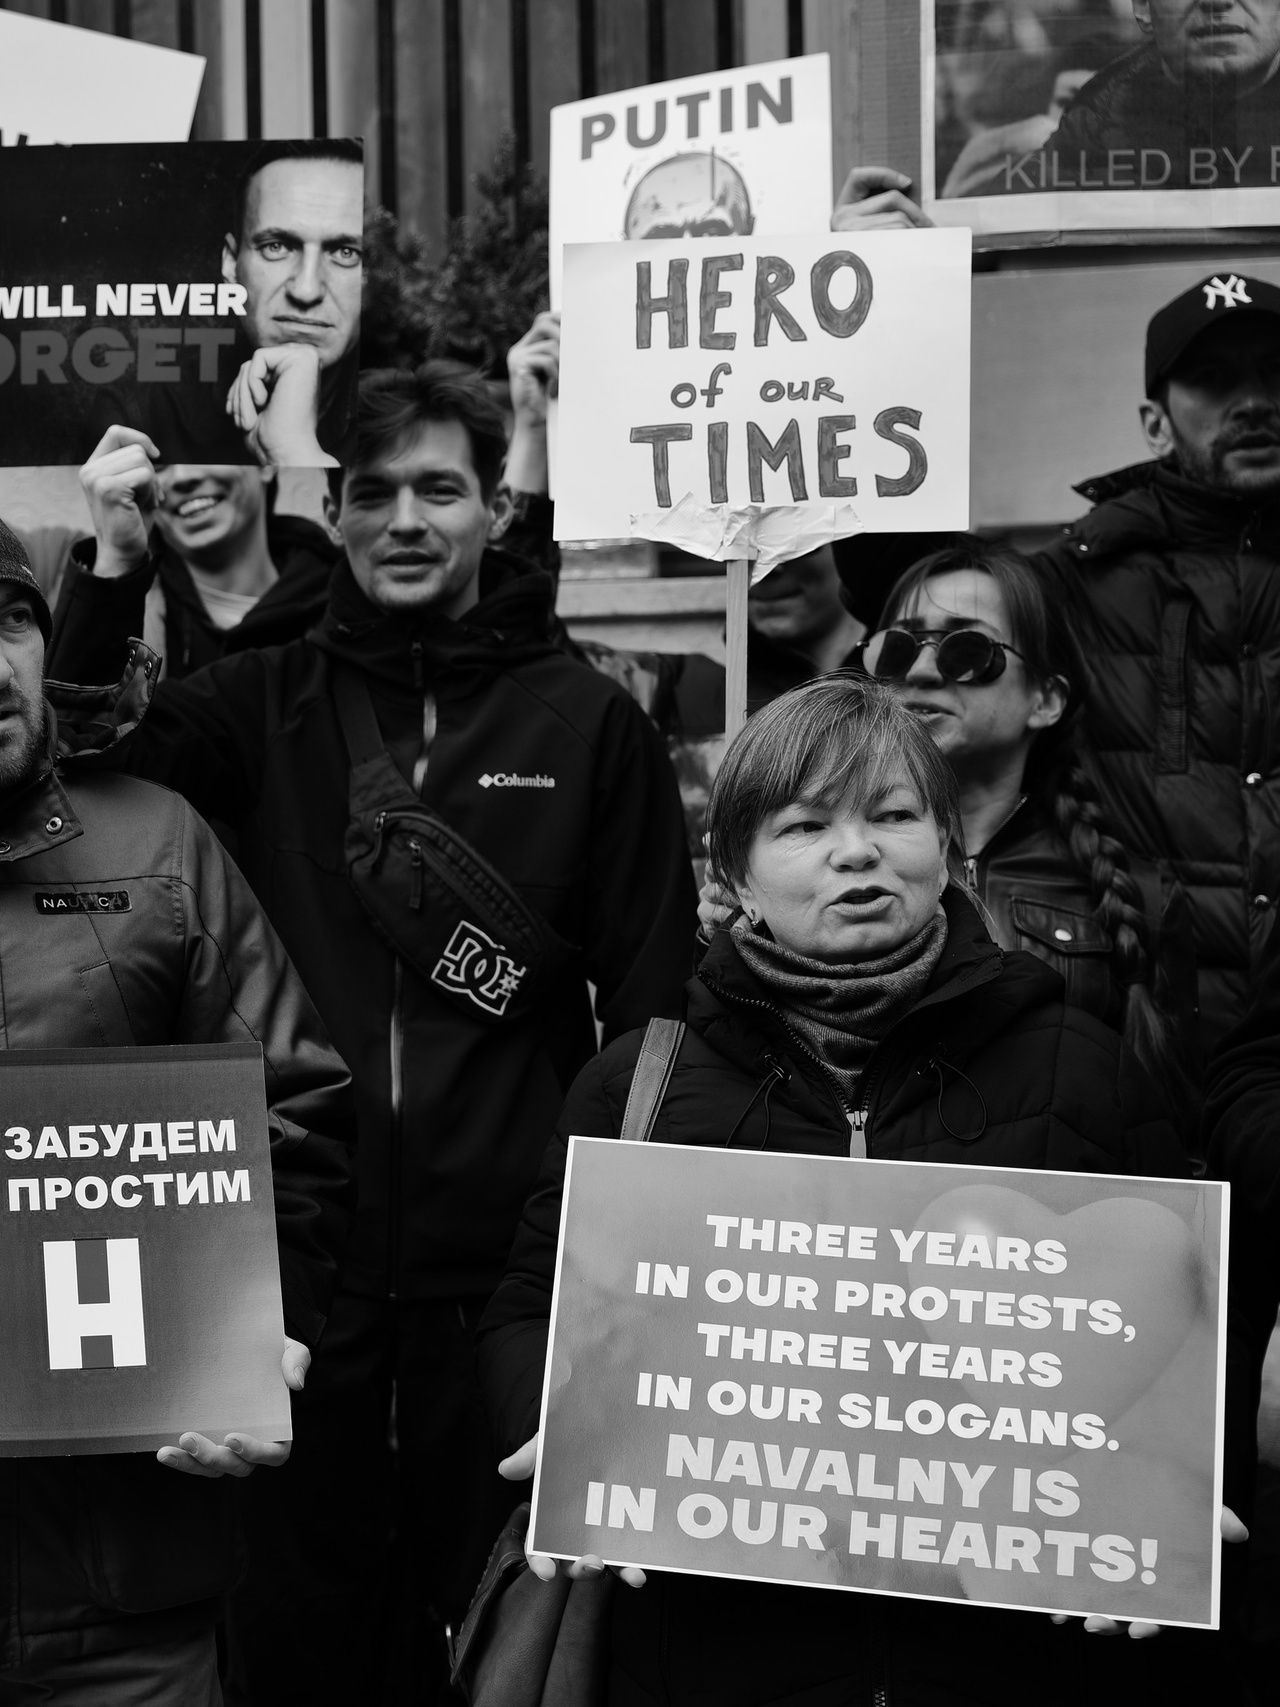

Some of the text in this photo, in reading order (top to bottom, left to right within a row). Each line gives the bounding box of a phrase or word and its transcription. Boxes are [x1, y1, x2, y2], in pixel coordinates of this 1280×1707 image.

[580, 75, 793, 160] PUTIN
[1005, 148, 1172, 190] KILLED
[1190, 145, 1254, 186] BY
[95, 283, 248, 316] NEVER
[636, 250, 873, 350] HERO
[670, 362, 732, 408] of
[629, 406, 928, 508] TIMES
[493, 773, 555, 788] Columbia
[4, 1119, 237, 1162] ЗАБУДЕМ
[9, 1170, 251, 1212] ПРОСТИМ
[707, 1215, 1067, 1274] THREE YEARS
[635, 1262, 1136, 1342] IN OUR PROTESTS,
[697, 1323, 1062, 1388] THREE YEARS
[637, 1373, 1120, 1451] IN OUR SLOGANS.
[666, 1434, 1080, 1517] NAVALNY IS
[585, 1481, 1159, 1585] IN OUR HEARTS!
